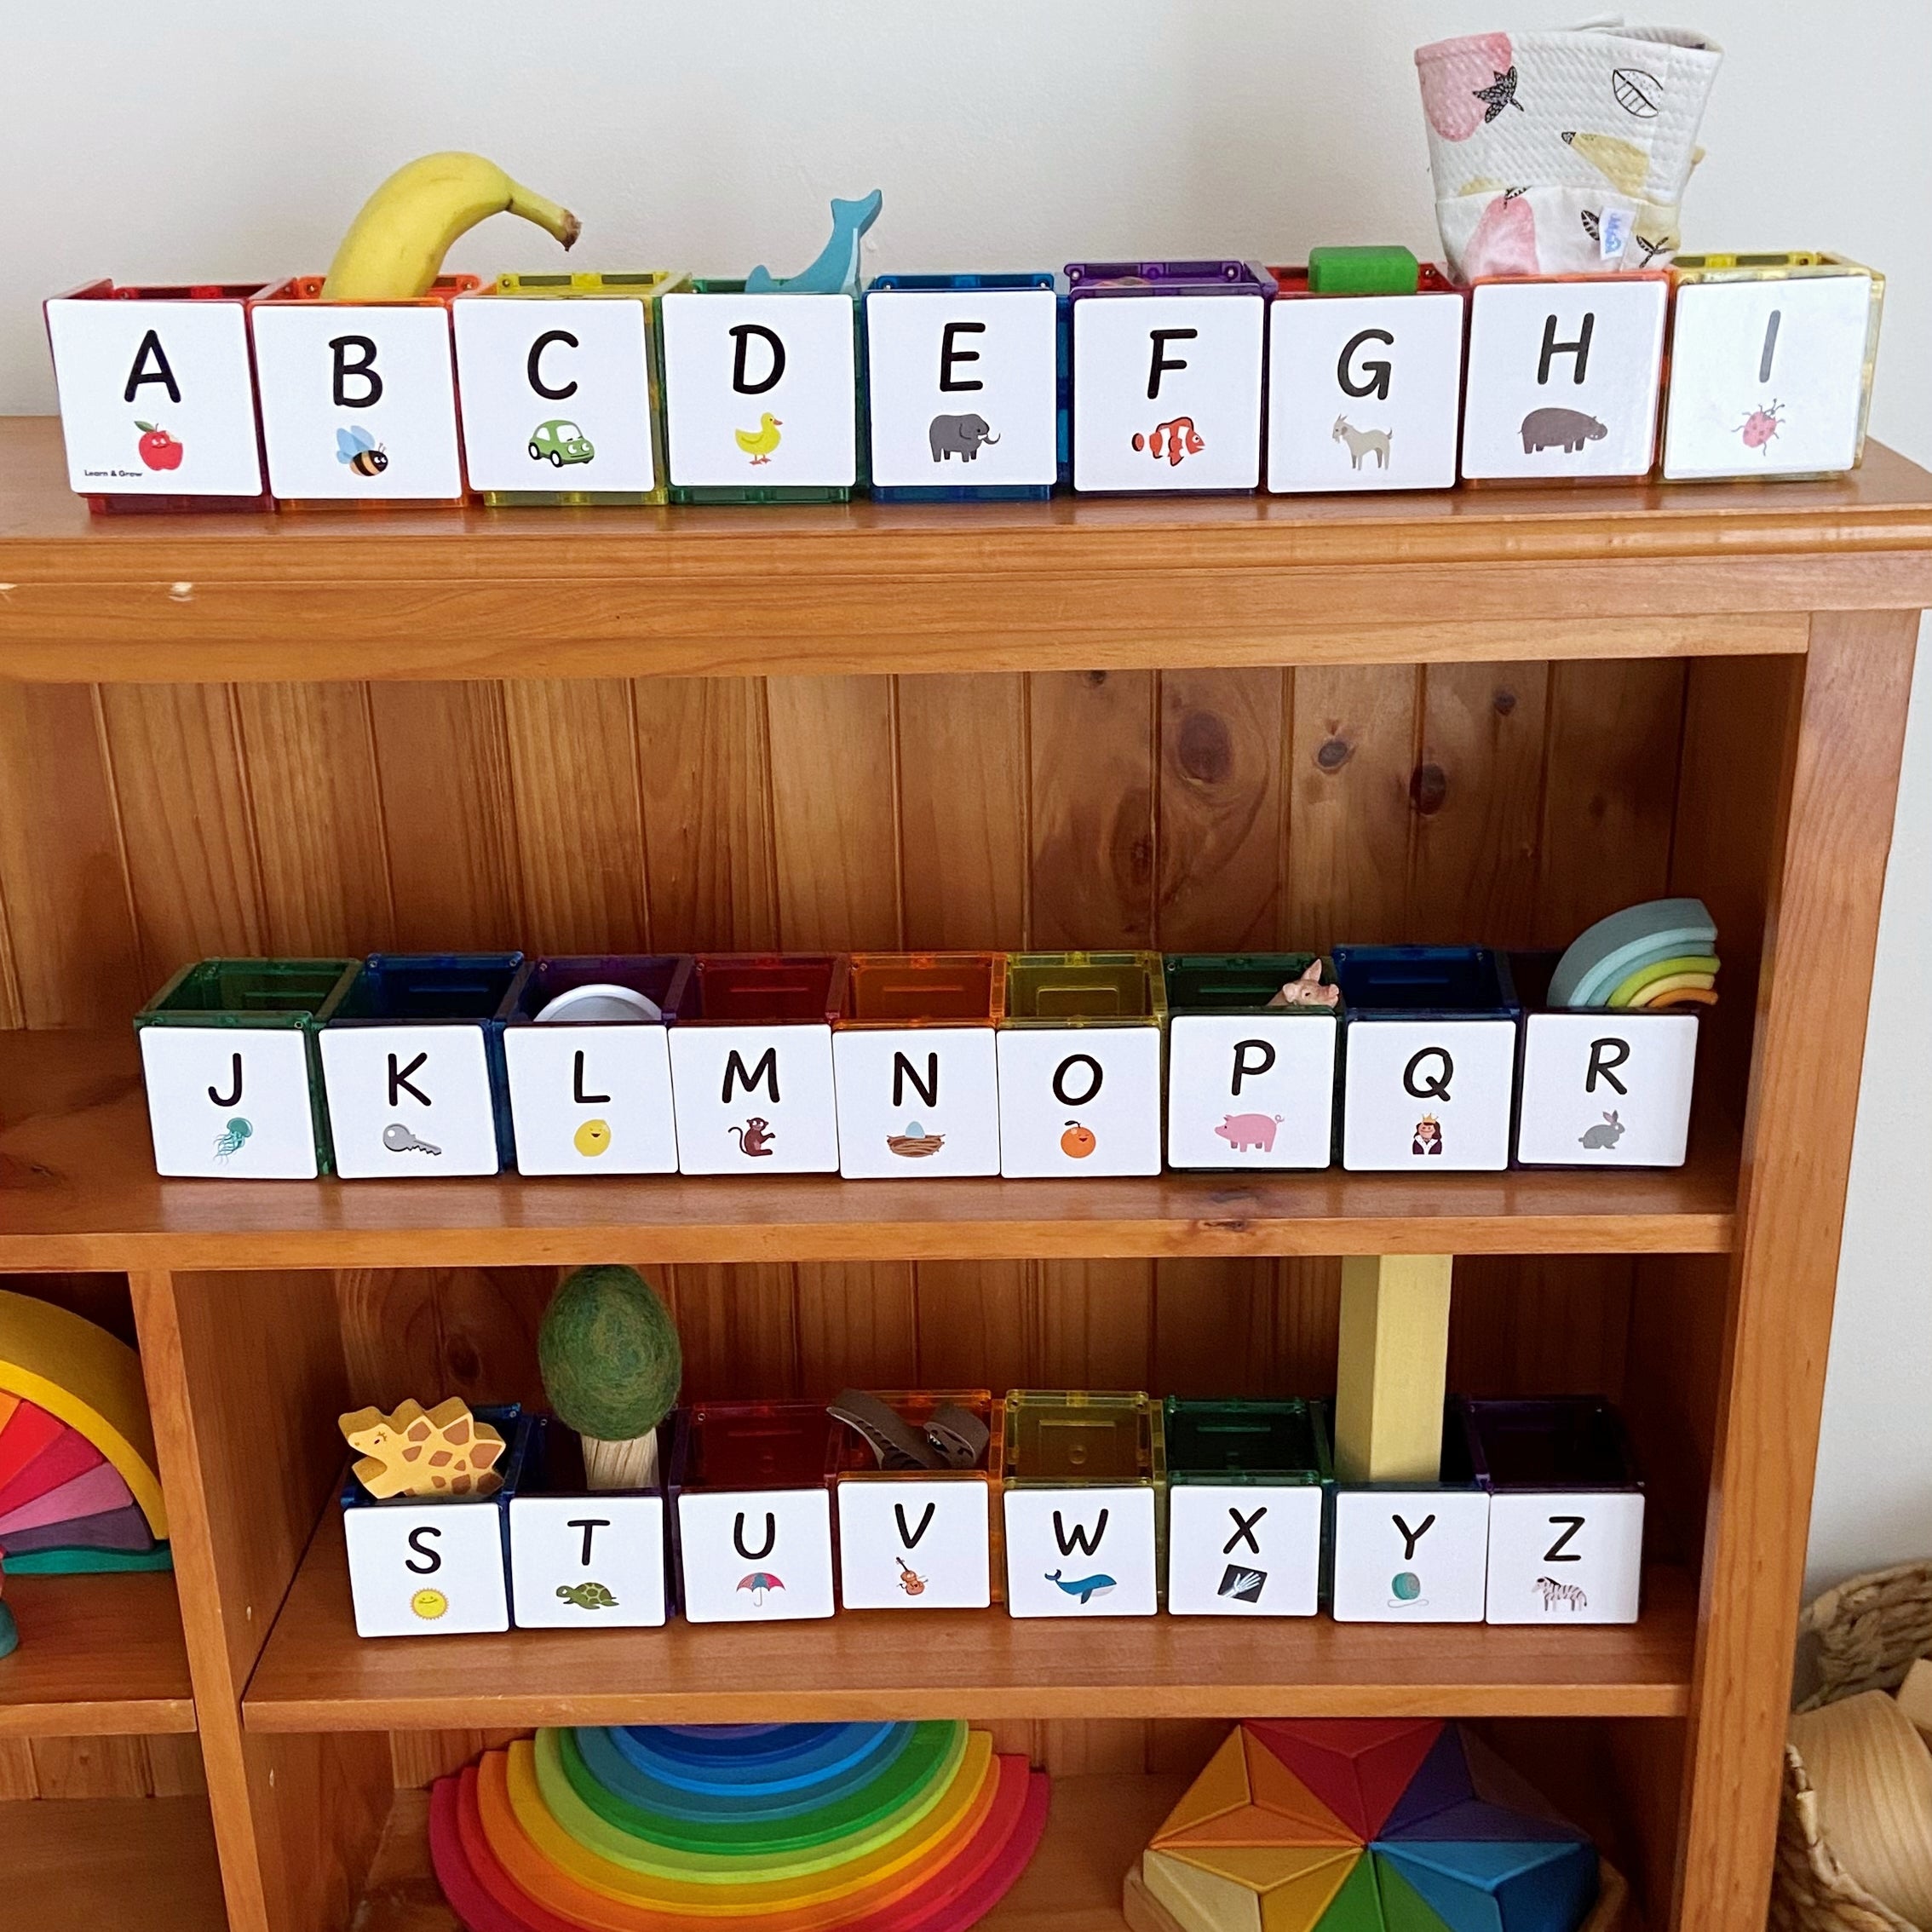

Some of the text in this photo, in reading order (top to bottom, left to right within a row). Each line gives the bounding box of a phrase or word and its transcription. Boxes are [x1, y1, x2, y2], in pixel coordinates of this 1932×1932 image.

[124, 329, 181, 404] A
[328, 335, 383, 409] B
[526, 330, 579, 400] C
[728, 324, 786, 395] D
[939, 322, 986, 393] E
[1147, 328, 1199, 400] F
[1337, 328, 1394, 400] G
[1537, 312, 1595, 385] H
[1759, 310, 1781, 383] I
[207, 1052, 243, 1107] J
[388, 1052, 432, 1107] K
[573, 1049, 612, 1104] L
[722, 1047, 780, 1104] M
[892, 1051, 938, 1108] N
[1052, 1054, 1104, 1107] O
[1231, 1038, 1276, 1096] P
[1403, 1046, 1454, 1102] Q
[1585, 1037, 1630, 1095] R
[405, 1526, 442, 1575] S
[566, 1519, 611, 1567] T
[733, 1512, 776, 1561] U
[894, 1502, 936, 1550] V
[1052, 1508, 1109, 1556] W
[1222, 1506, 1268, 1555] X
[1391, 1514, 1436, 1561] Y
[1543, 1515, 1585, 1562] Z
